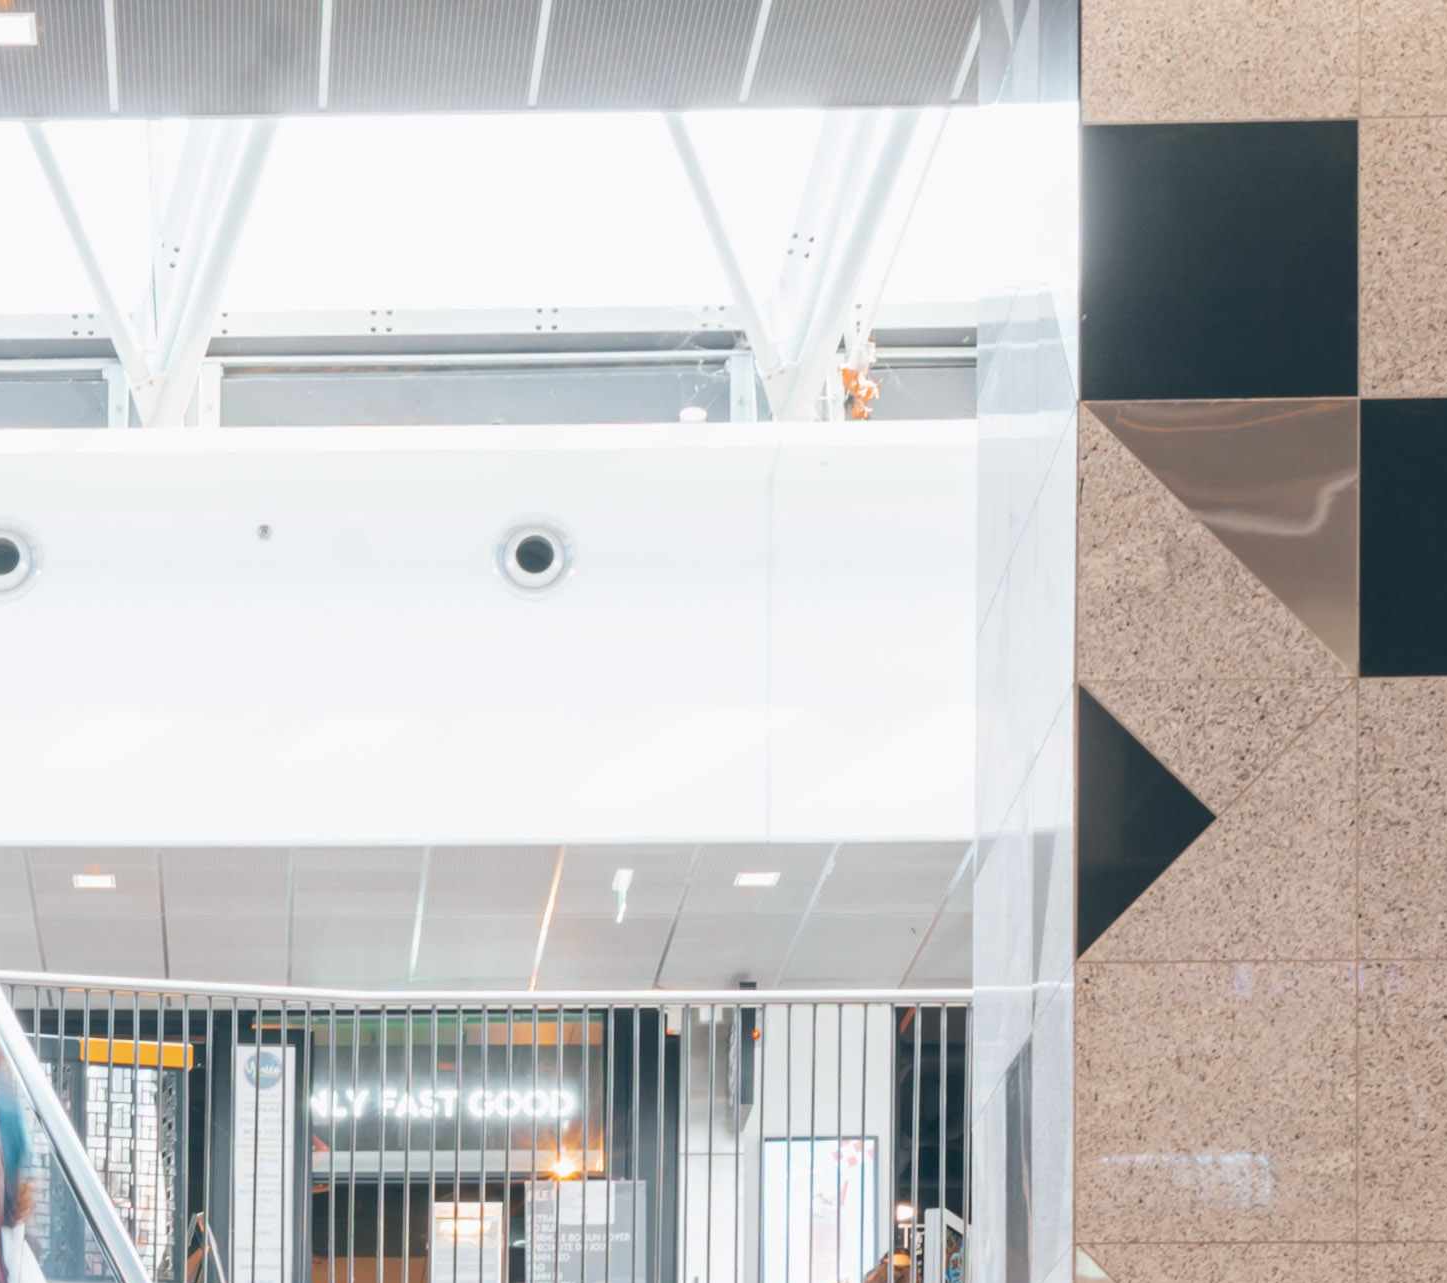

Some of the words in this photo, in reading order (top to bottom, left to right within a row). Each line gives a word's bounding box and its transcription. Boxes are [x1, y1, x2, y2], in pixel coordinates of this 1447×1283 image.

[310, 1088, 369, 1118] NLY
[381, 1088, 458, 1118] FAST
[468, 1088, 575, 1118] GOOD
